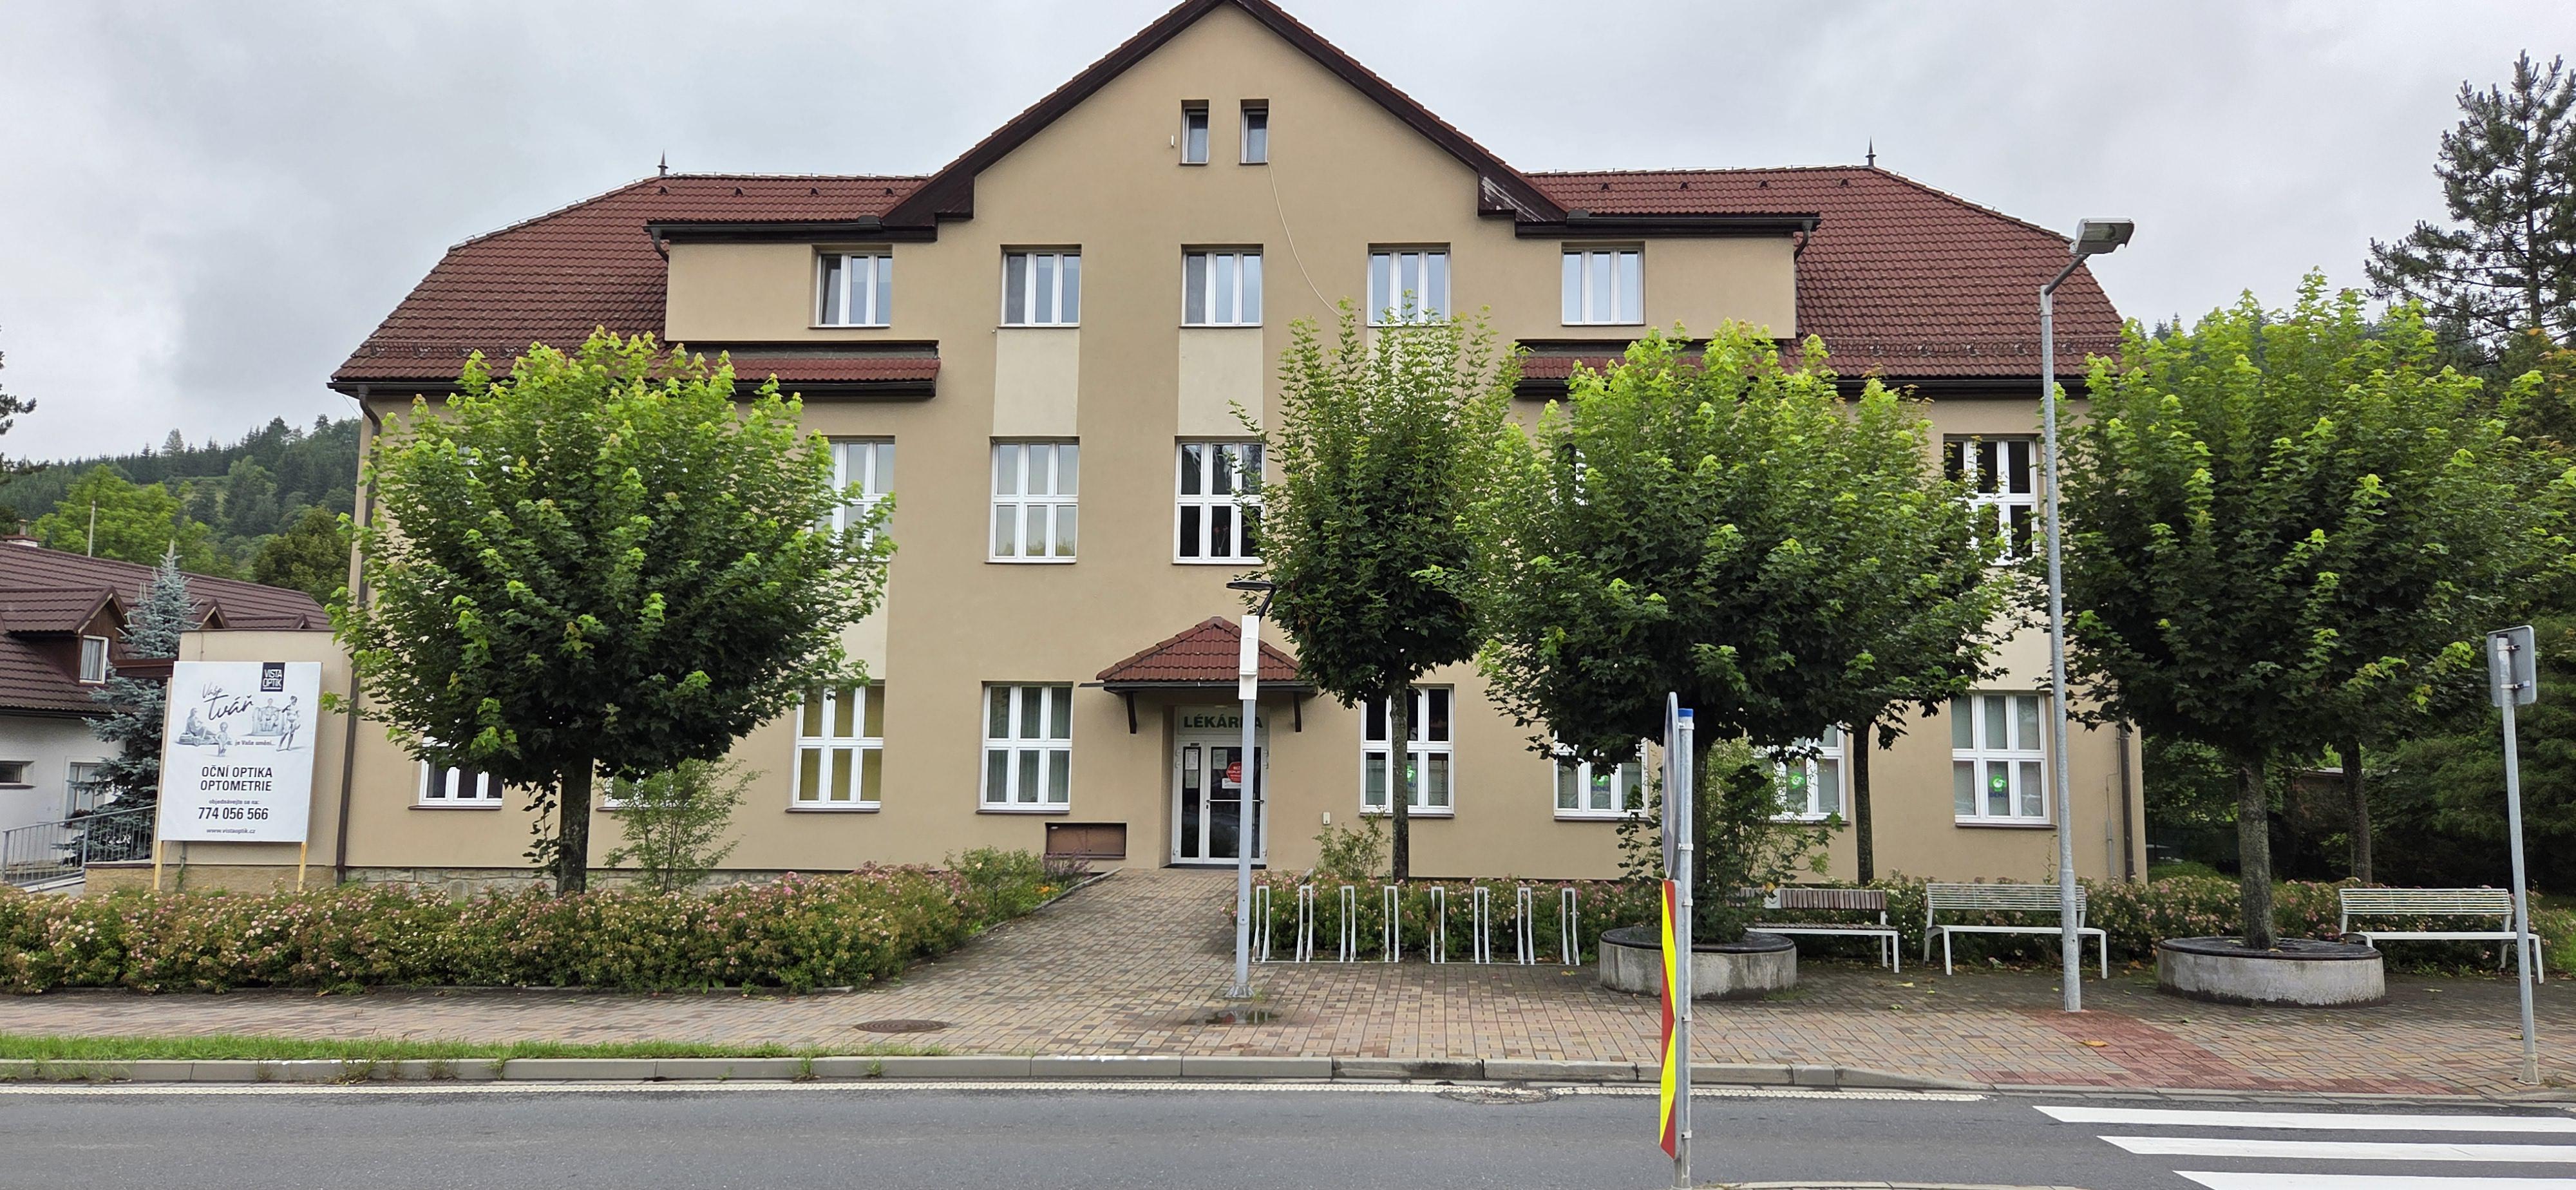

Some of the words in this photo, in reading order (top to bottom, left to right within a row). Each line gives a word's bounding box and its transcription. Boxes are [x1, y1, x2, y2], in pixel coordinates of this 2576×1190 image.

[263, 669, 282, 677] VISTA
[262, 678, 282, 687] OPTIK
[1184, 713, 1263, 728] LÉKÁRA
[202, 765, 230, 777] OČNÍ
[232, 767, 272, 778] OPTIKA
[200, 780, 272, 791] OPTOMETRIE
[198, 807, 219, 819] 774
[222, 807, 244, 820] 056
[247, 808, 269, 820] 566
